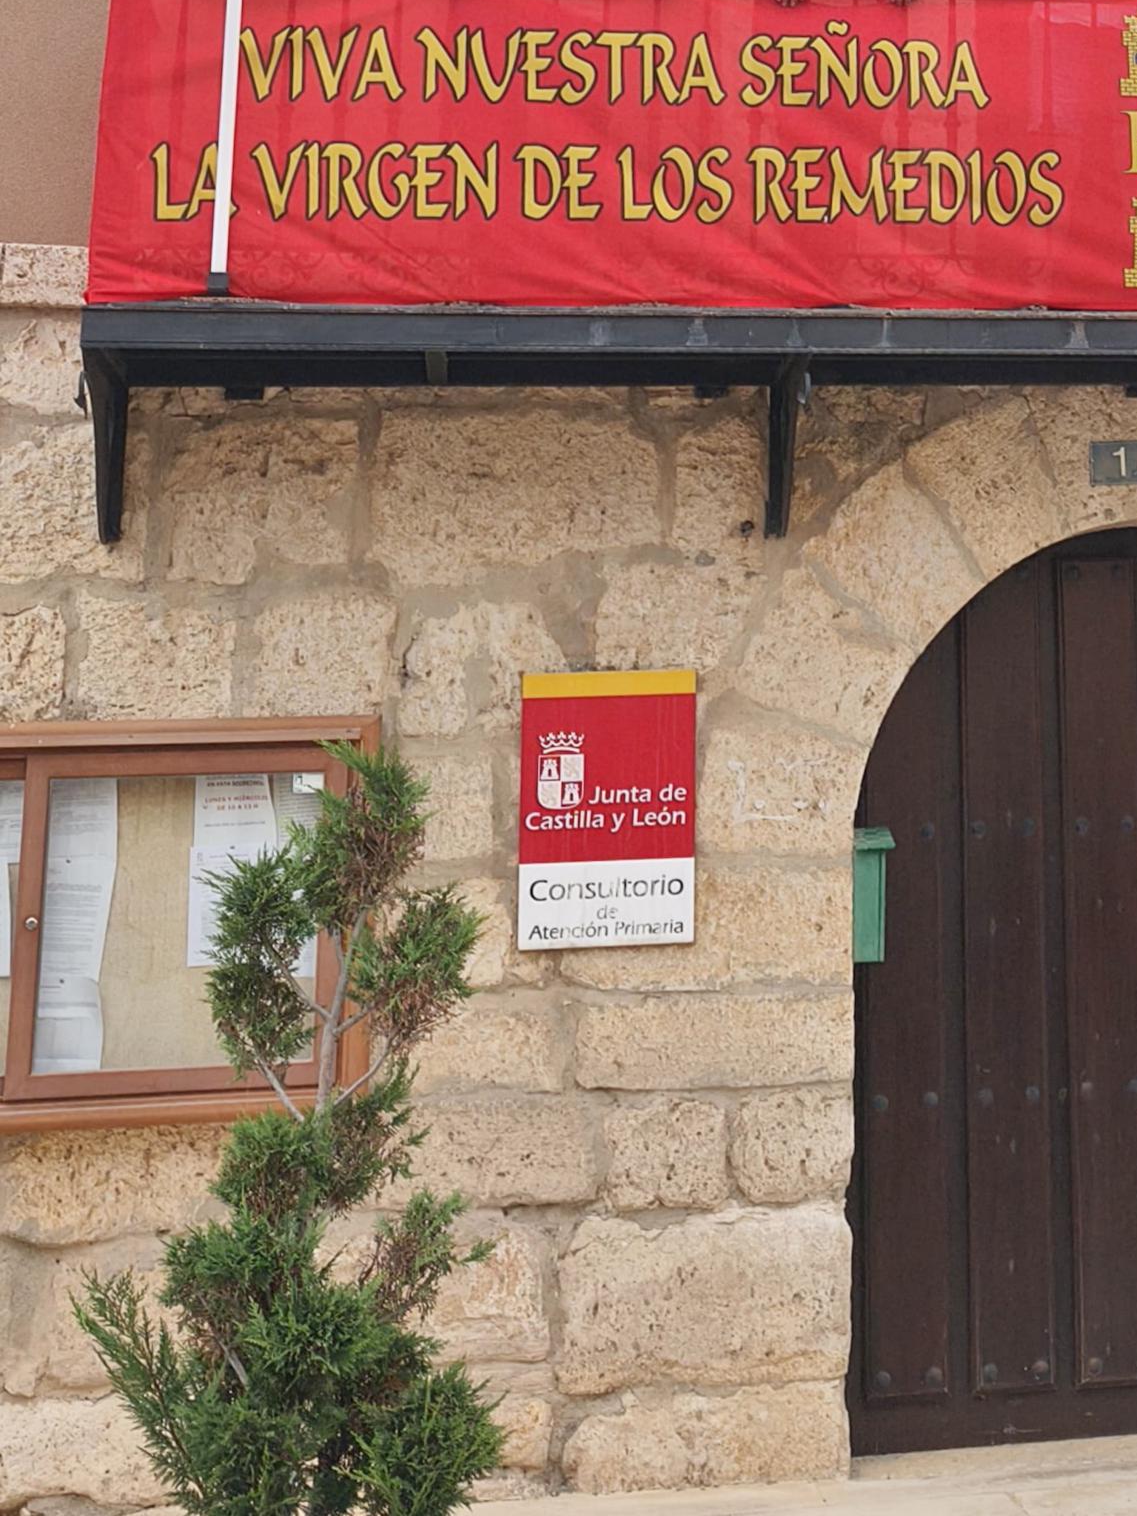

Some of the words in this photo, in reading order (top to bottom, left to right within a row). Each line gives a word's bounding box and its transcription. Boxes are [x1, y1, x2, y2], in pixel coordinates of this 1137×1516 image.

[240, 24, 404, 102] VIVA
[416, 25, 726, 107] NUESTRA
[739, 21, 990, 109] SEÑORA
[250, 141, 498, 221] VIRGEN
[514, 143, 603, 222] DE
[617, 144, 734, 225] LOS
[746, 146, 1066, 228] REMEDIOS
[1111, 445, 1127, 477] 1
[588, 785, 652, 805] Junta
[658, 783, 688, 802] de
[524, 809, 605, 831] Castilla
[610, 812, 625, 833] y
[632, 806, 687, 827] León
[529, 874, 685, 902] Consultorio
[596, 904, 618, 920] de
[528, 922, 609, 941] Atención
[614, 918, 685, 936] Primaria
